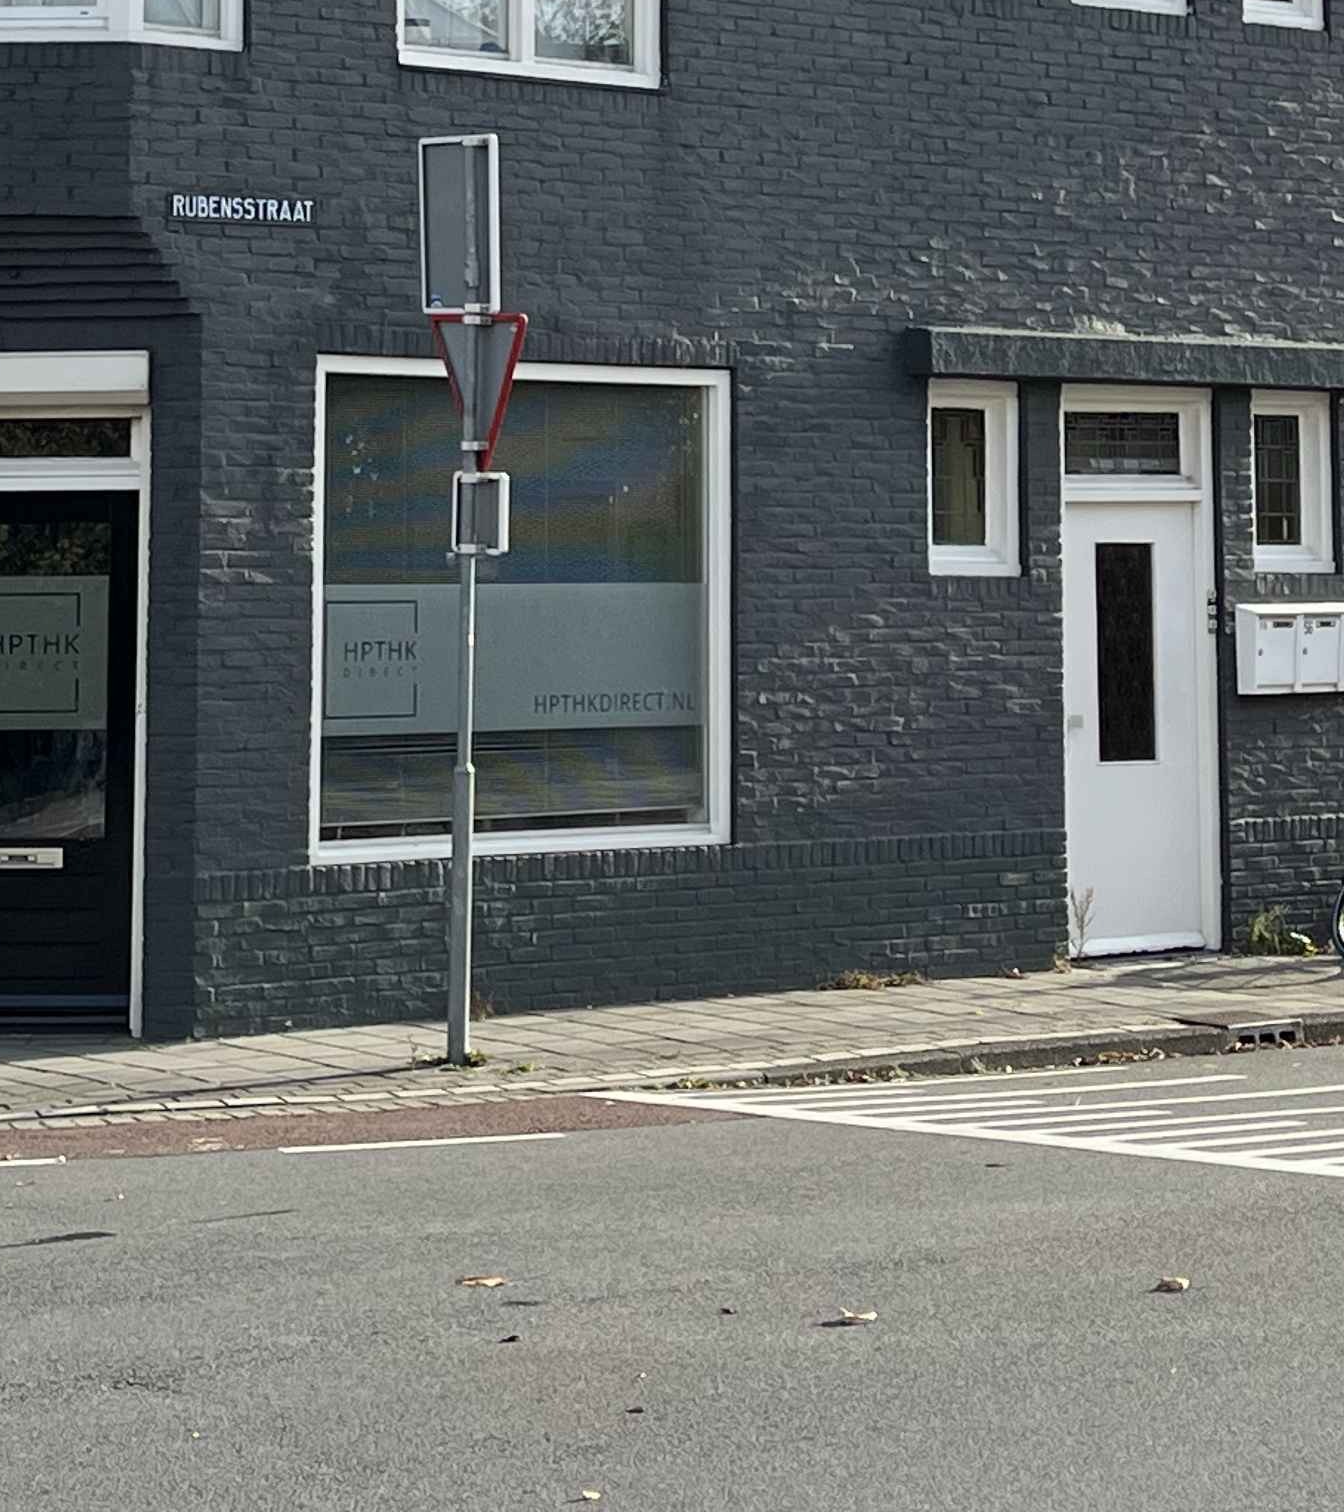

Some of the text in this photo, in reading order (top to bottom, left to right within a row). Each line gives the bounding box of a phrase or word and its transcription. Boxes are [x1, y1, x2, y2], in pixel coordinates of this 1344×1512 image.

[172, 194, 314, 222] RUBENSSTRAAT
[344, 640, 416, 662] HPTHK
[534, 692, 697, 714] HPTHKDIRECT.NL
